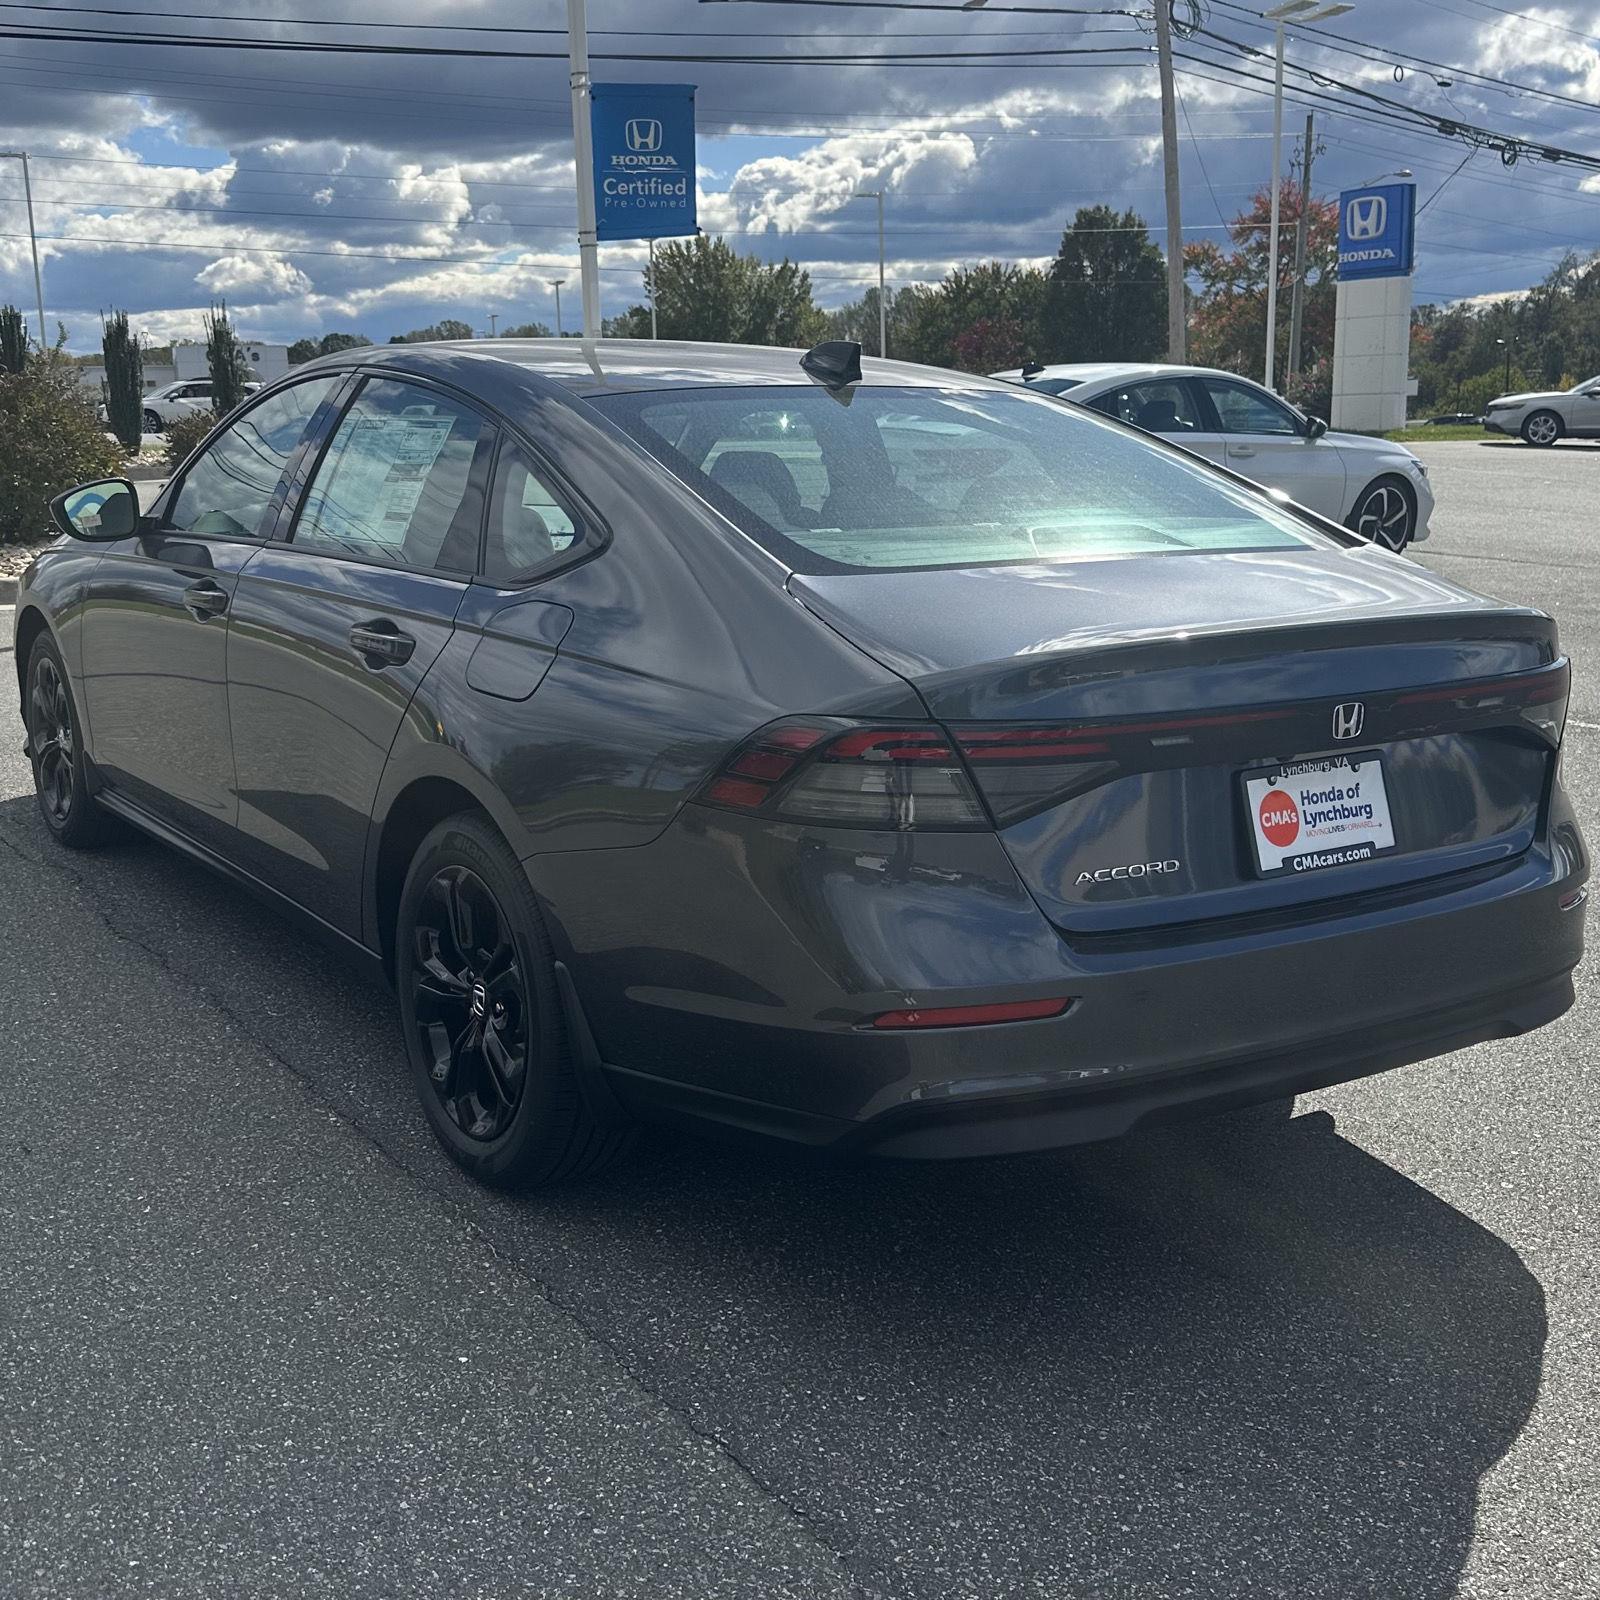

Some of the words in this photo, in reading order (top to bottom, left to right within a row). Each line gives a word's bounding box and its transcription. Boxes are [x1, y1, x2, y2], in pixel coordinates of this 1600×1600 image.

[611, 155, 678, 166] HONDA
[603, 177, 687, 195] Certified
[604, 198, 687, 208] Pre-Owned
[1338, 248, 1396, 264] HONDA
[206, 346, 261, 362] CA's
[1334, 756, 1350, 768] VA
[1300, 786, 1344, 807] Honda
[1345, 782, 1361, 799] of
[1261, 809, 1298, 828] CMA's
[1302, 803, 1374, 829] Lynchburg
[1293, 847, 1371, 872] CMAcars.com
[1075, 859, 1180, 886] ACCORD
